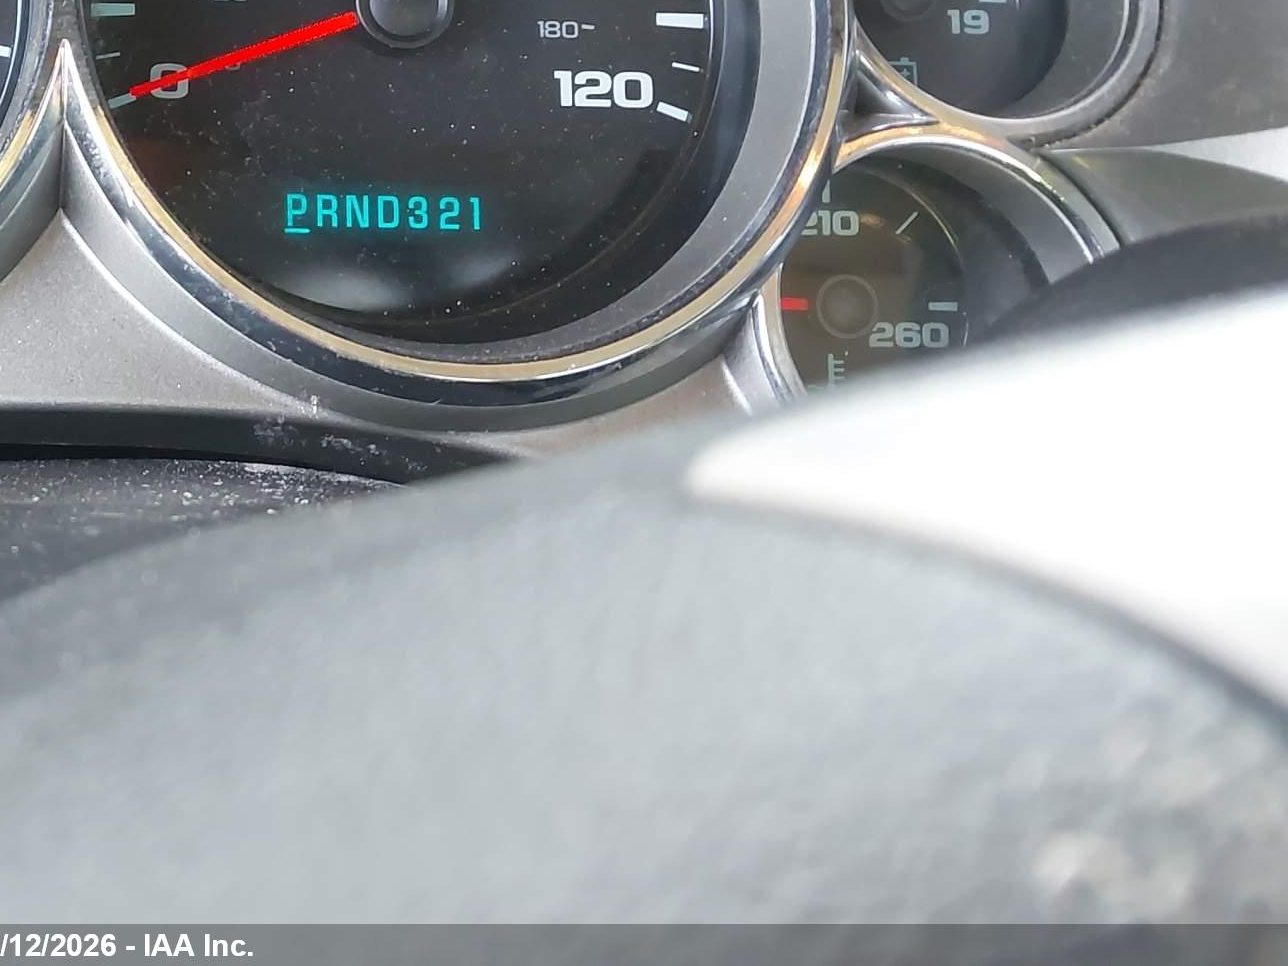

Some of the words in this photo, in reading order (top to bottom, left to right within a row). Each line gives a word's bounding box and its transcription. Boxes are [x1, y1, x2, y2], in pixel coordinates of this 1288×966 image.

[538, 21, 579, 39] 180
[947, 9, 990, 35] 19
[149, 64, 189, 100] 0
[554, 69, 654, 109] 120
[285, 193, 481, 231] PRND321
[869, 322, 949, 348] 260
